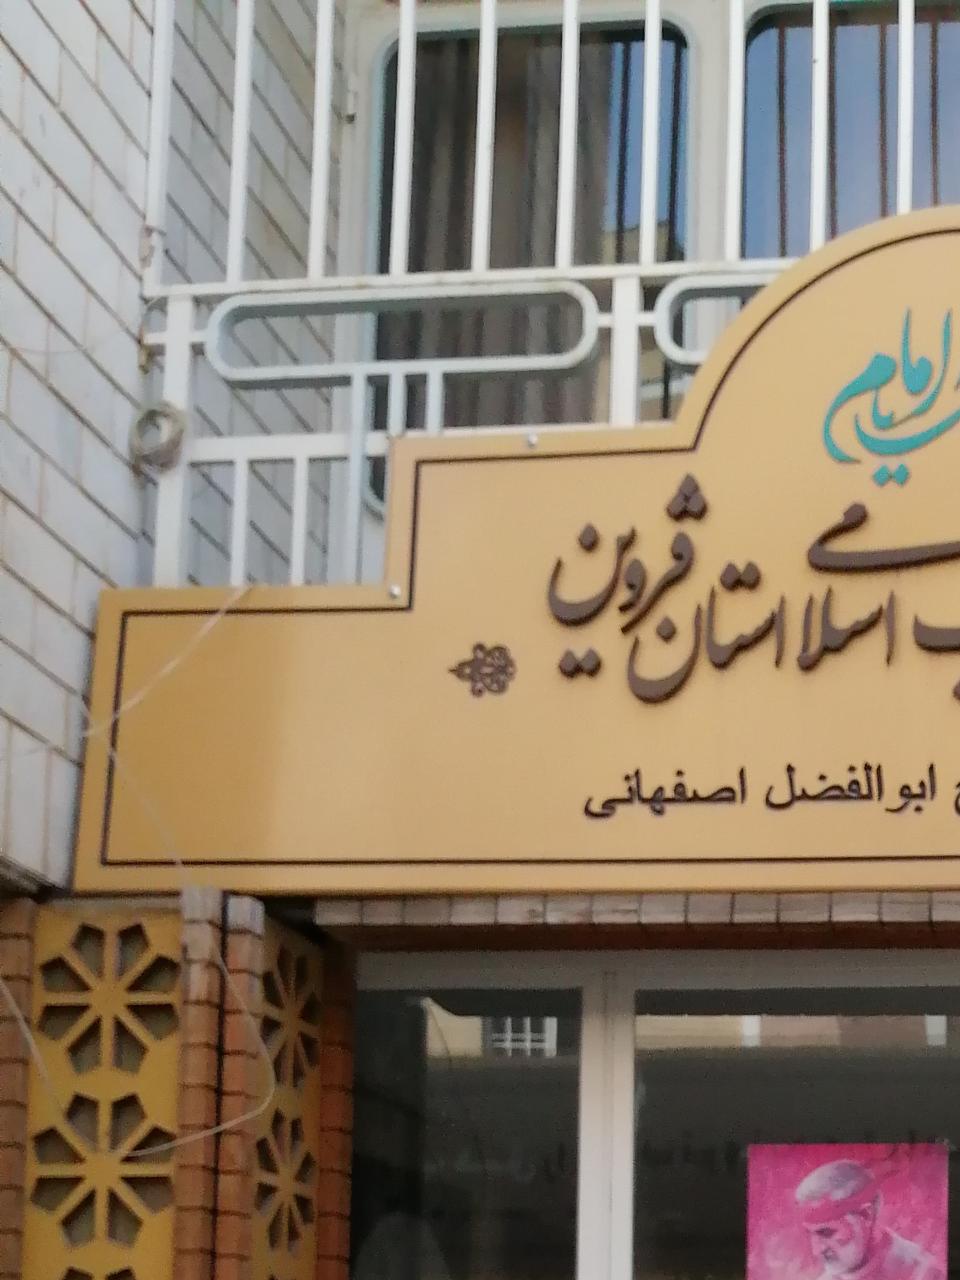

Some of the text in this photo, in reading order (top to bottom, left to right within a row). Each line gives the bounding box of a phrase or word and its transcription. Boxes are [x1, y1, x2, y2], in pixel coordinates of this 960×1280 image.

[823, 305, 952, 463] امام
[546, 472, 709, 678] قزوین
[626, 560, 786, 704] استان
[583, 766, 746, 819] اصفهانی
[764, 761, 938, 812] ابوالفضل
